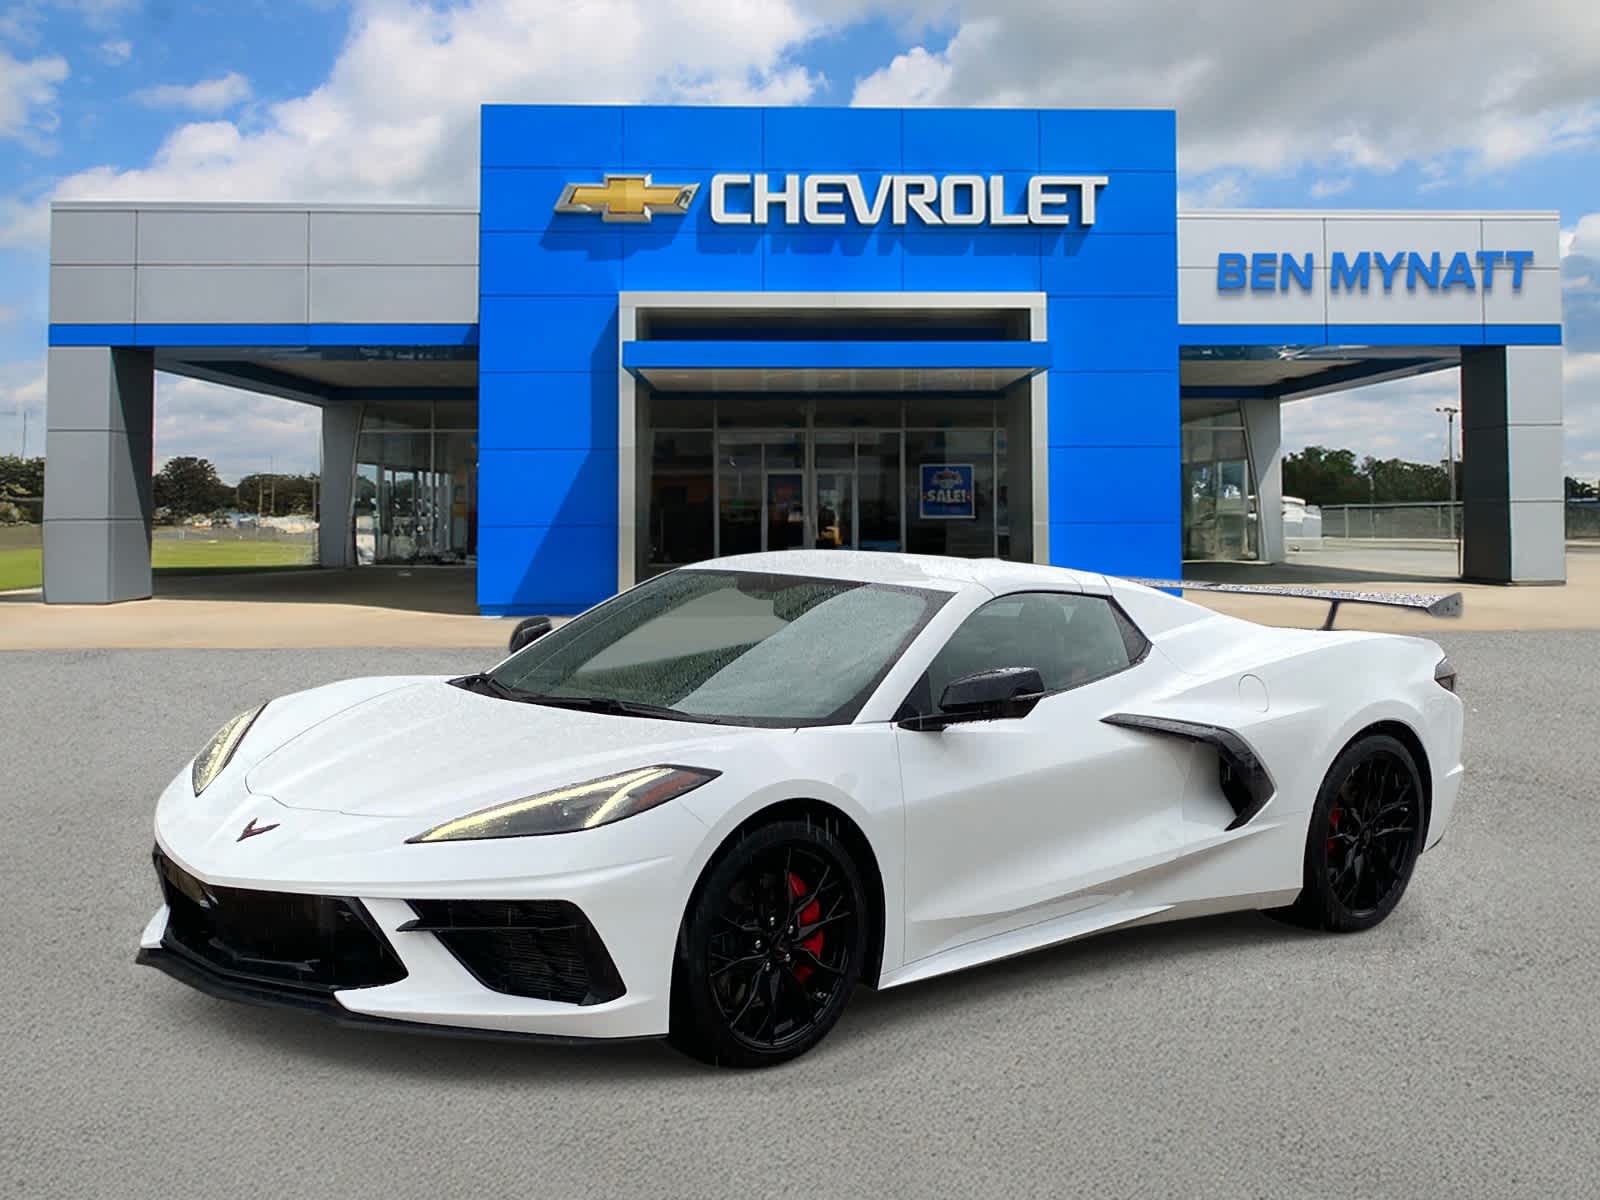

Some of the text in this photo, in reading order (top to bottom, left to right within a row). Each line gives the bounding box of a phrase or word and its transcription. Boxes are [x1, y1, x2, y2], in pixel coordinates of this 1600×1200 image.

[710, 173, 1110, 226] CHEVROLET
[1217, 250, 1535, 292] BEN MYNATT
